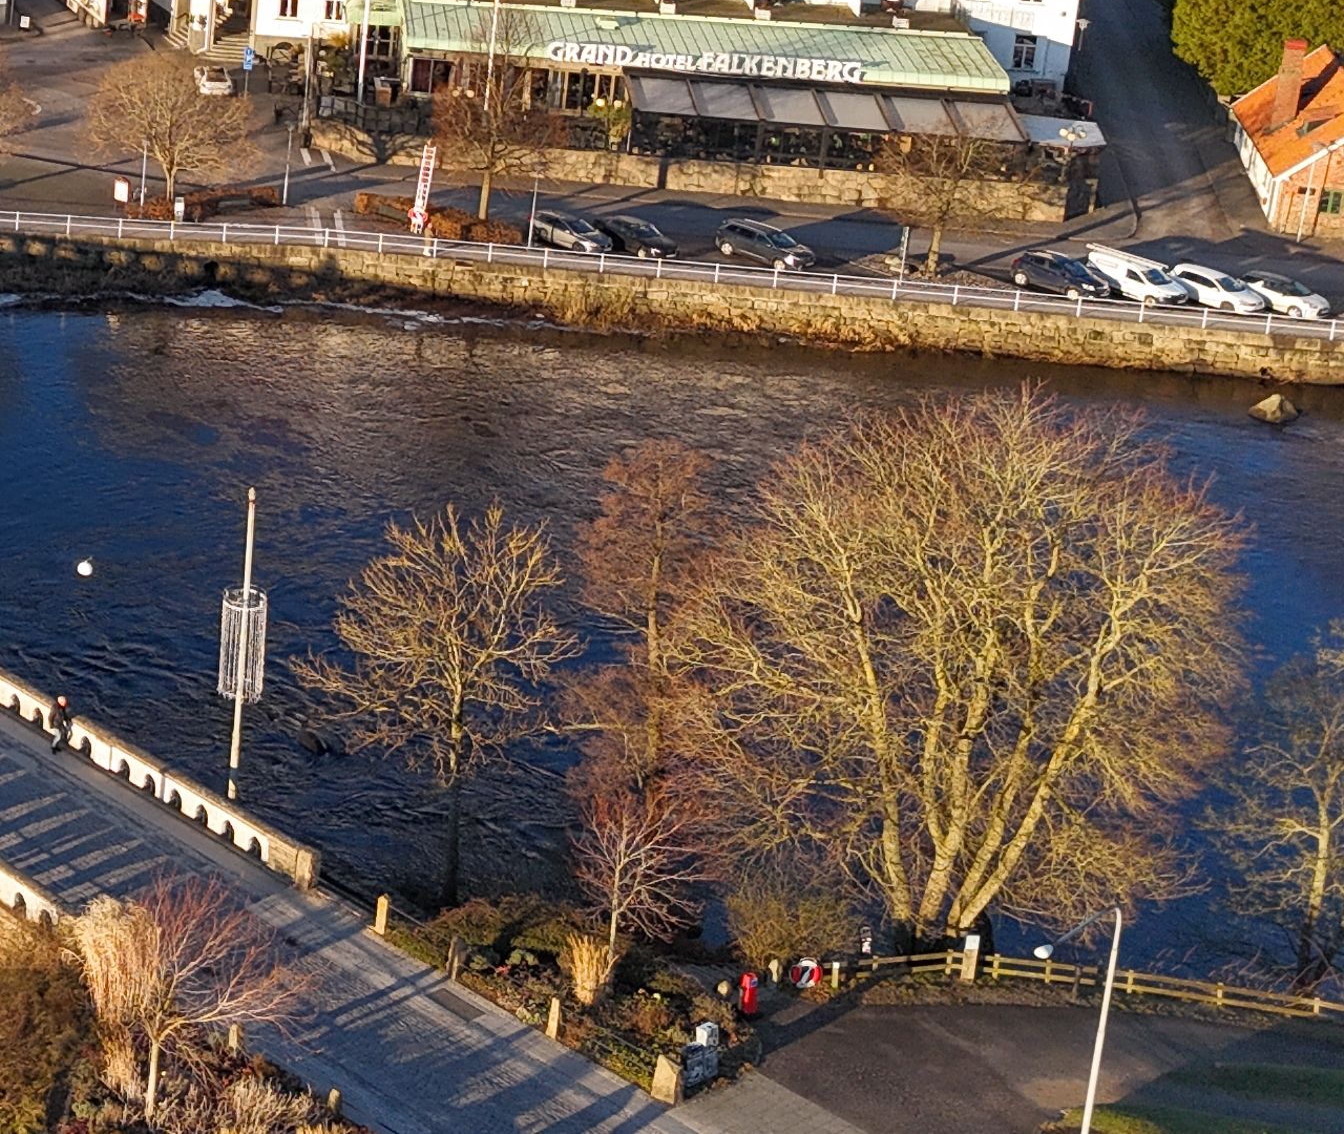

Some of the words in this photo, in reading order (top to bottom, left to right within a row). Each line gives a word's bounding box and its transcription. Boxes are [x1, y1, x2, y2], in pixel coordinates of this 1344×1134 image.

[547, 41, 633, 66] GRAND
[631, 52, 697, 71] HOTEL
[696, 51, 862, 83] FALKENBERG
